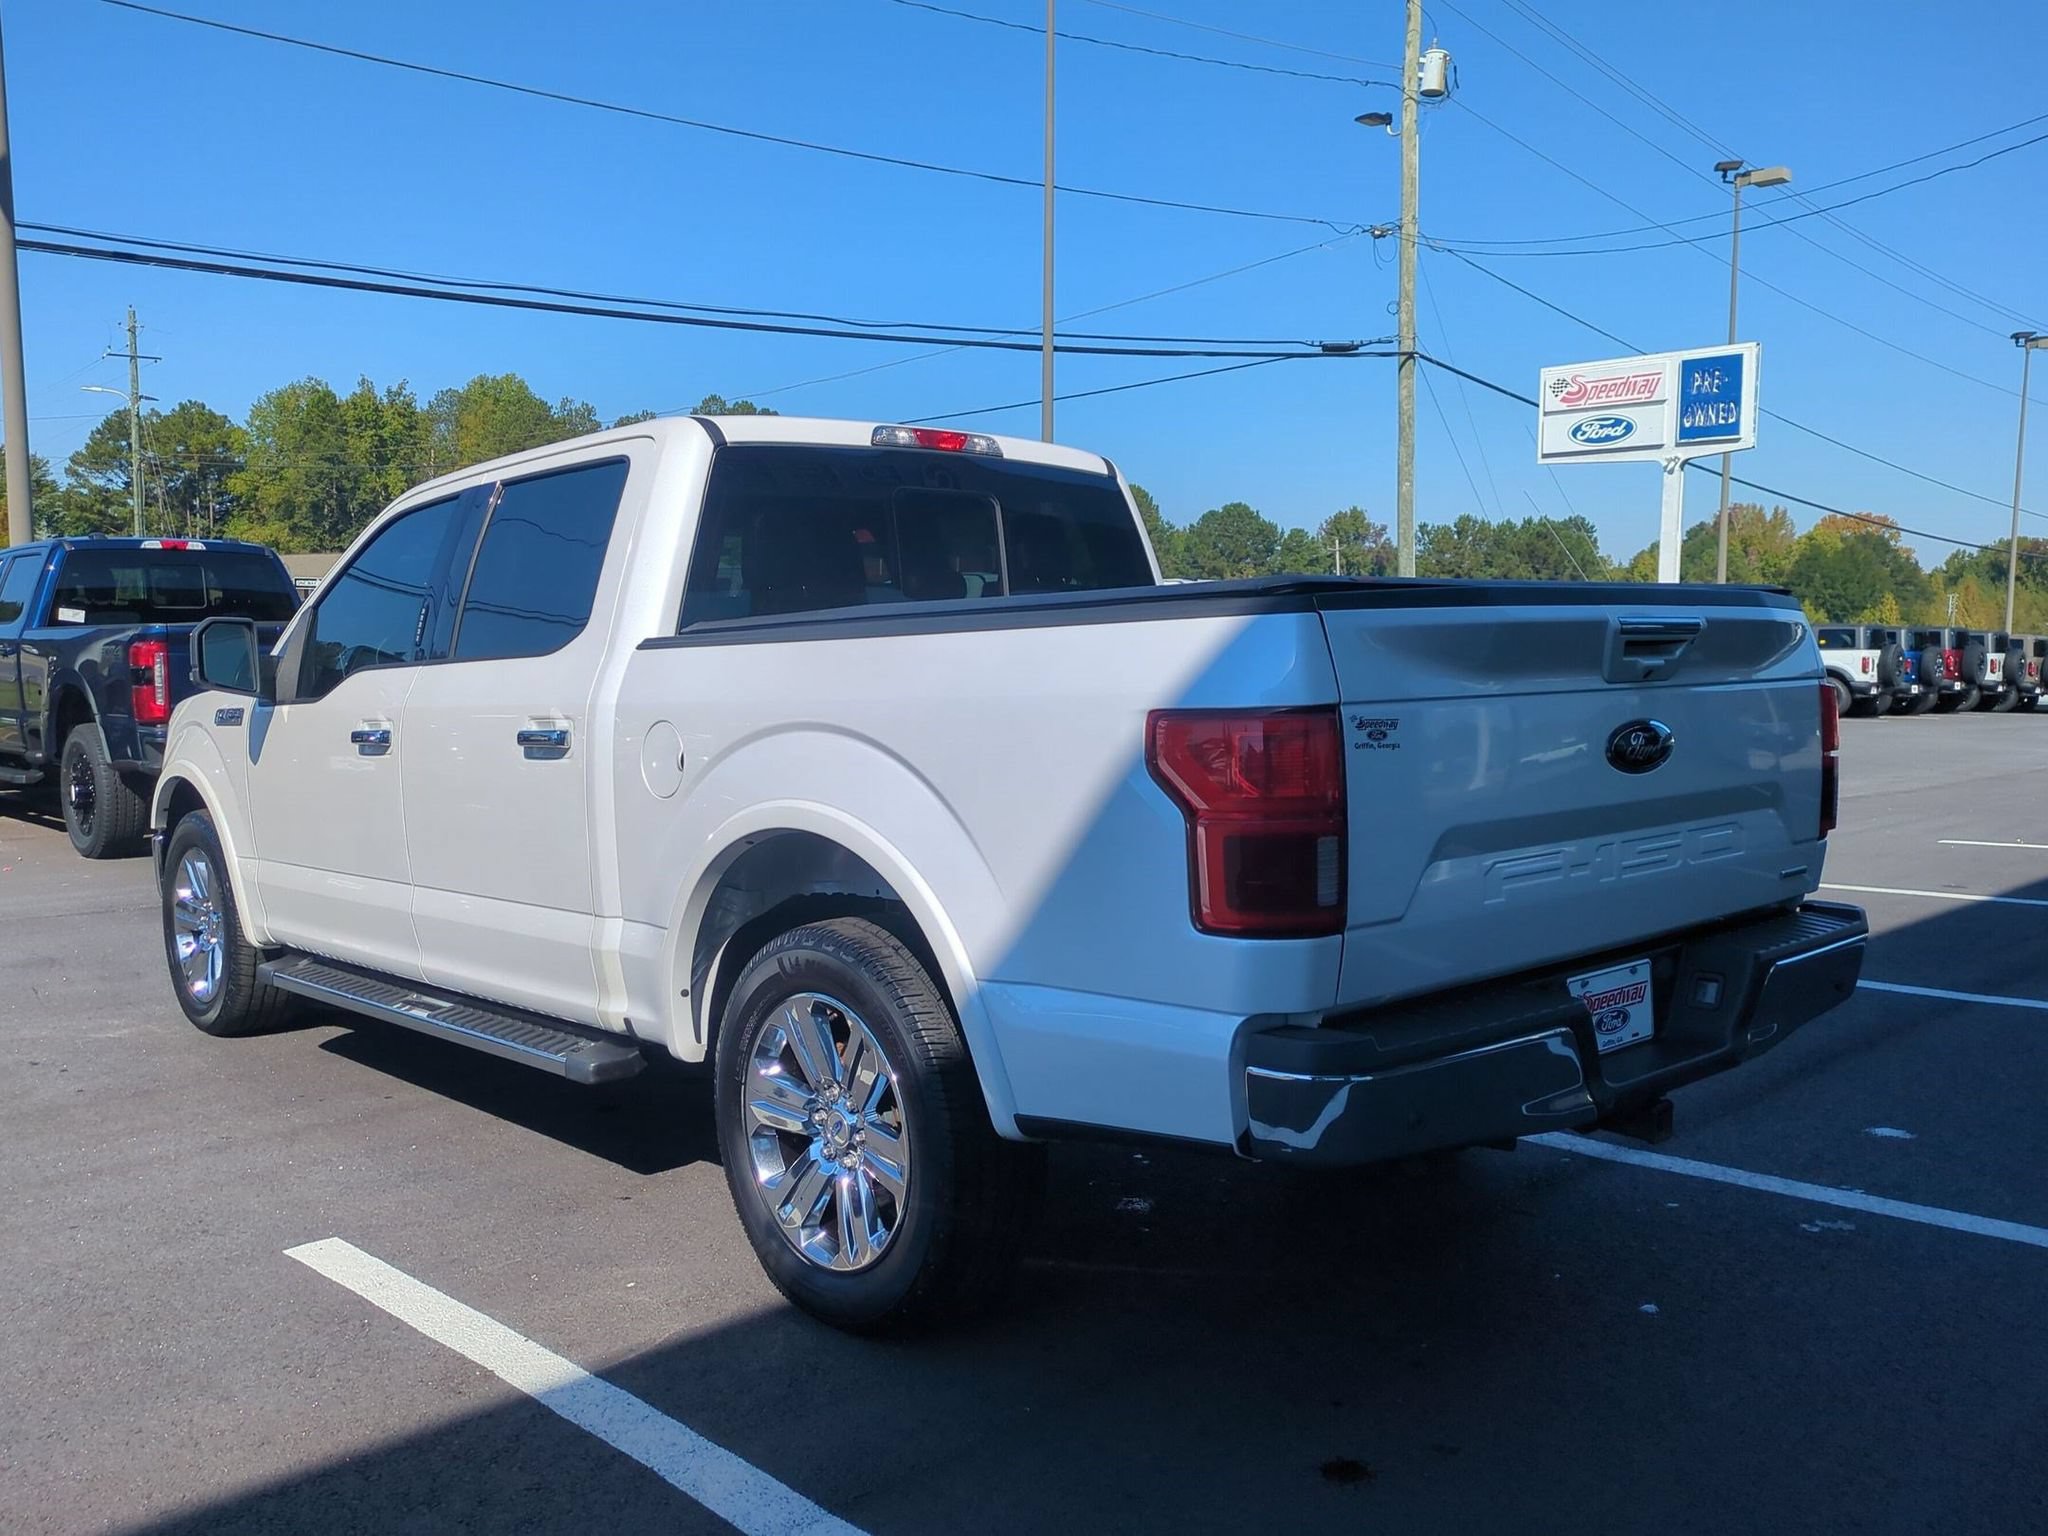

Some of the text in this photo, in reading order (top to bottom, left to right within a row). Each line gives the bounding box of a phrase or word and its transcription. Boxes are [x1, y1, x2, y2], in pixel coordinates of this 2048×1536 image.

[1560, 373, 1662, 406] Speedway
[1576, 418, 1627, 441] Ford
[1683, 402, 1737, 428] OWNED
[1355, 716, 1399, 731] Speedway
[1482, 821, 1745, 904] F-150
[1583, 981, 1648, 1014] Speedway
